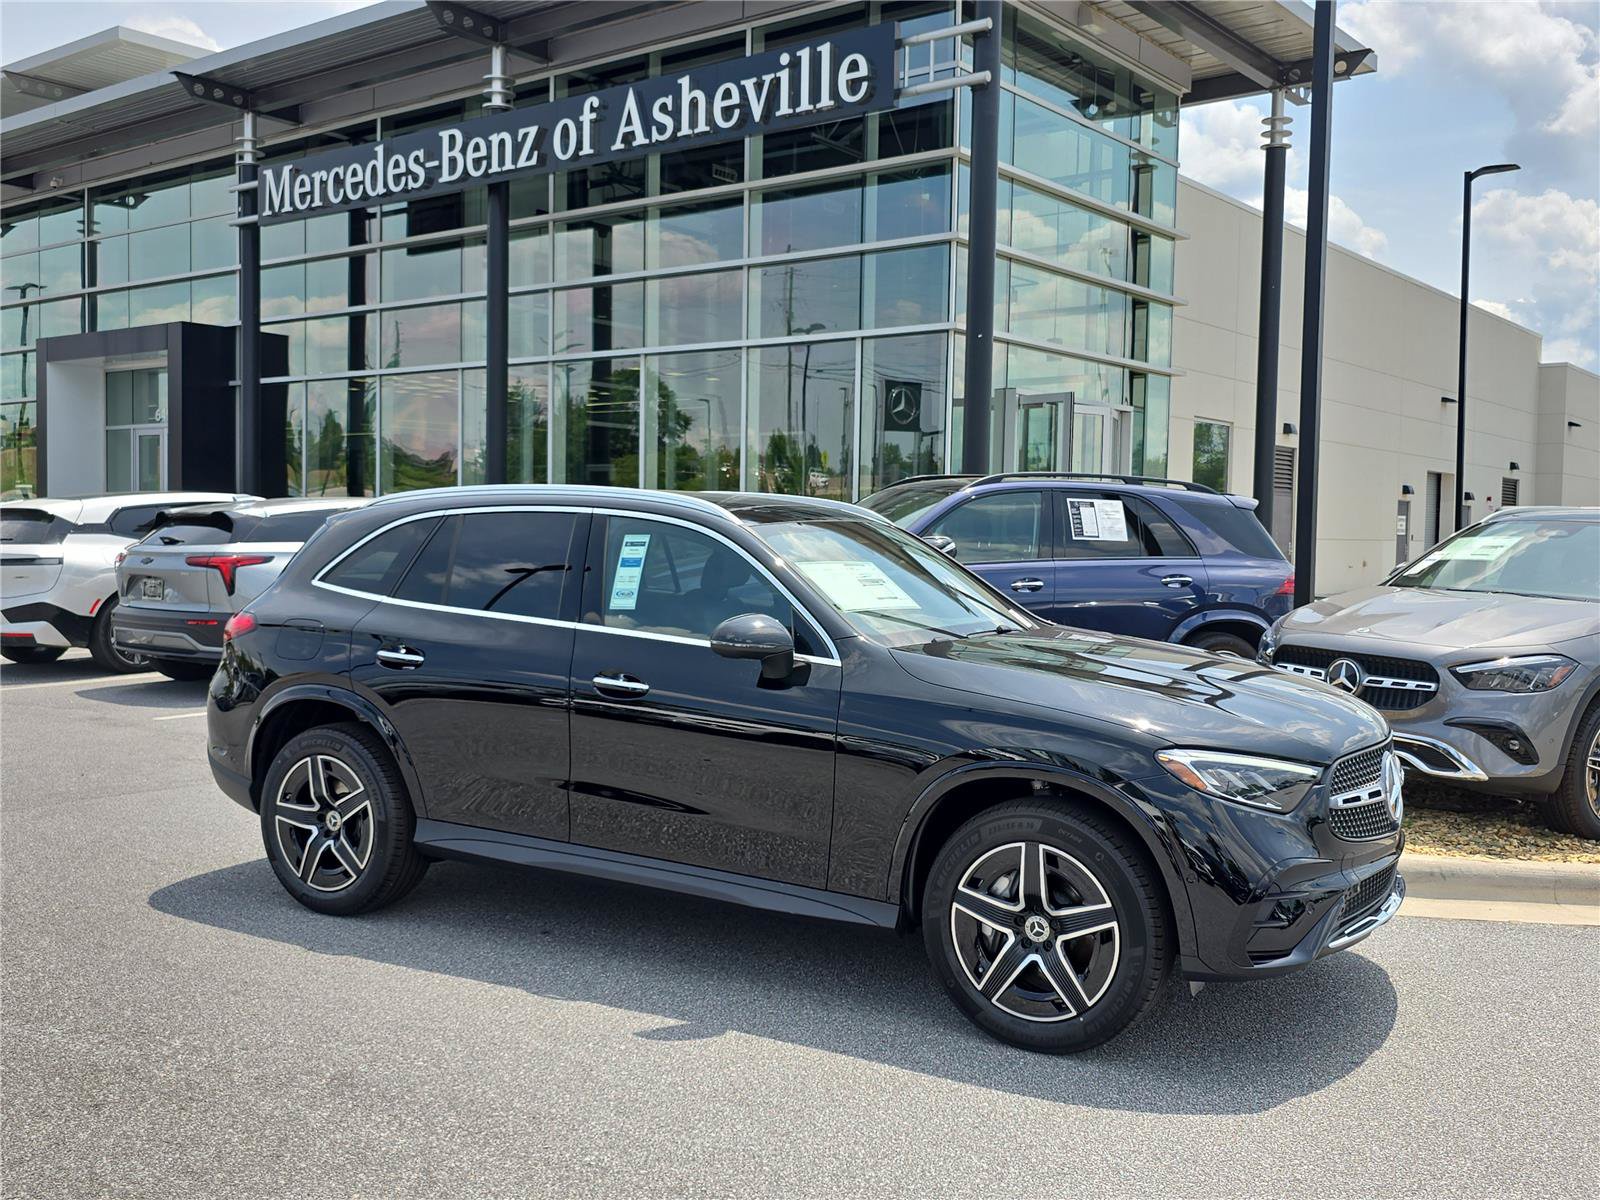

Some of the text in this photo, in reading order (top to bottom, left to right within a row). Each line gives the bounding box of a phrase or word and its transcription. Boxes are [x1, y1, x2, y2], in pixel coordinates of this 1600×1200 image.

[262, 42, 870, 216] Mercedes-Benz of Asheville
